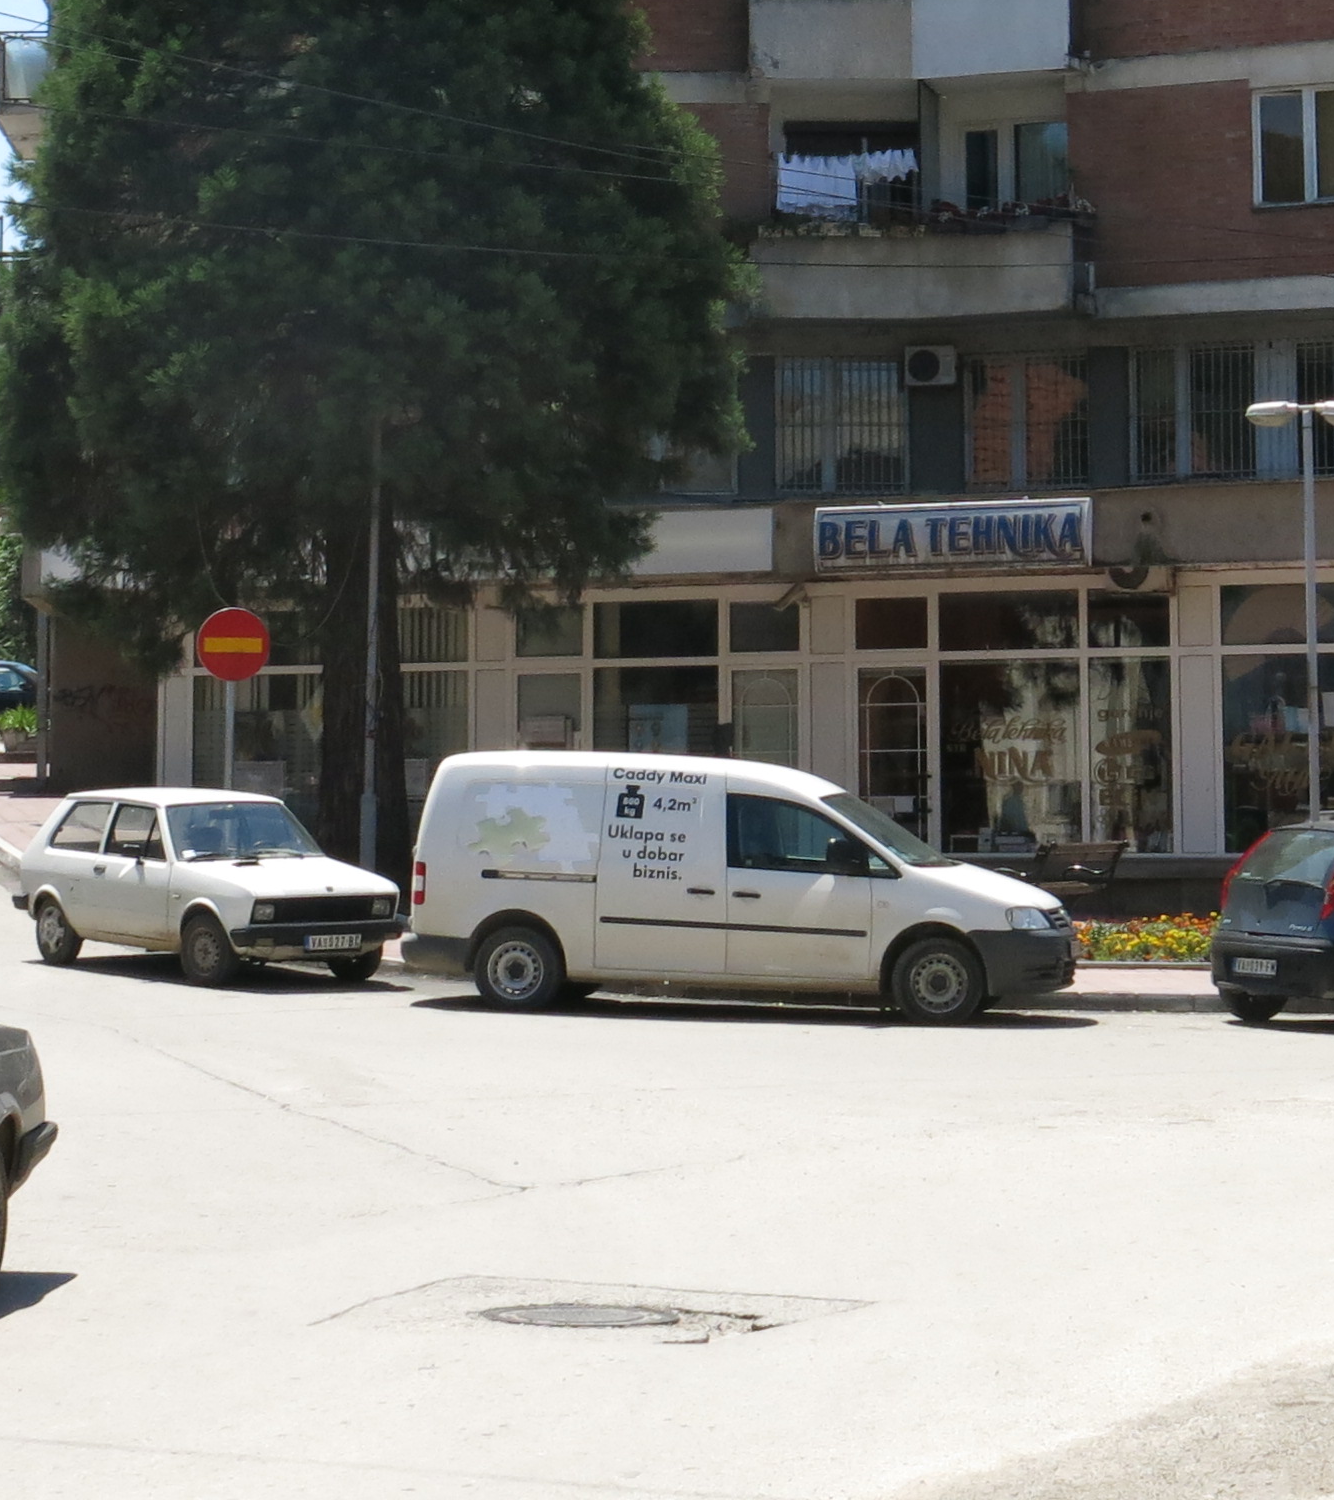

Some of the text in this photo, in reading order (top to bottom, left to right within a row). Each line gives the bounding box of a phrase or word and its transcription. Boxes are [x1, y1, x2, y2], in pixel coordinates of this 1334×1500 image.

[819, 512, 1085, 561] BELA TEHNIKA
[974, 746, 1055, 784] NINA
[613, 767, 707, 785] Caddy Maxi
[608, 824, 687, 844] Uklapa se
[622, 845, 685, 862] u dobar
[633, 862, 683, 881] biznis.
